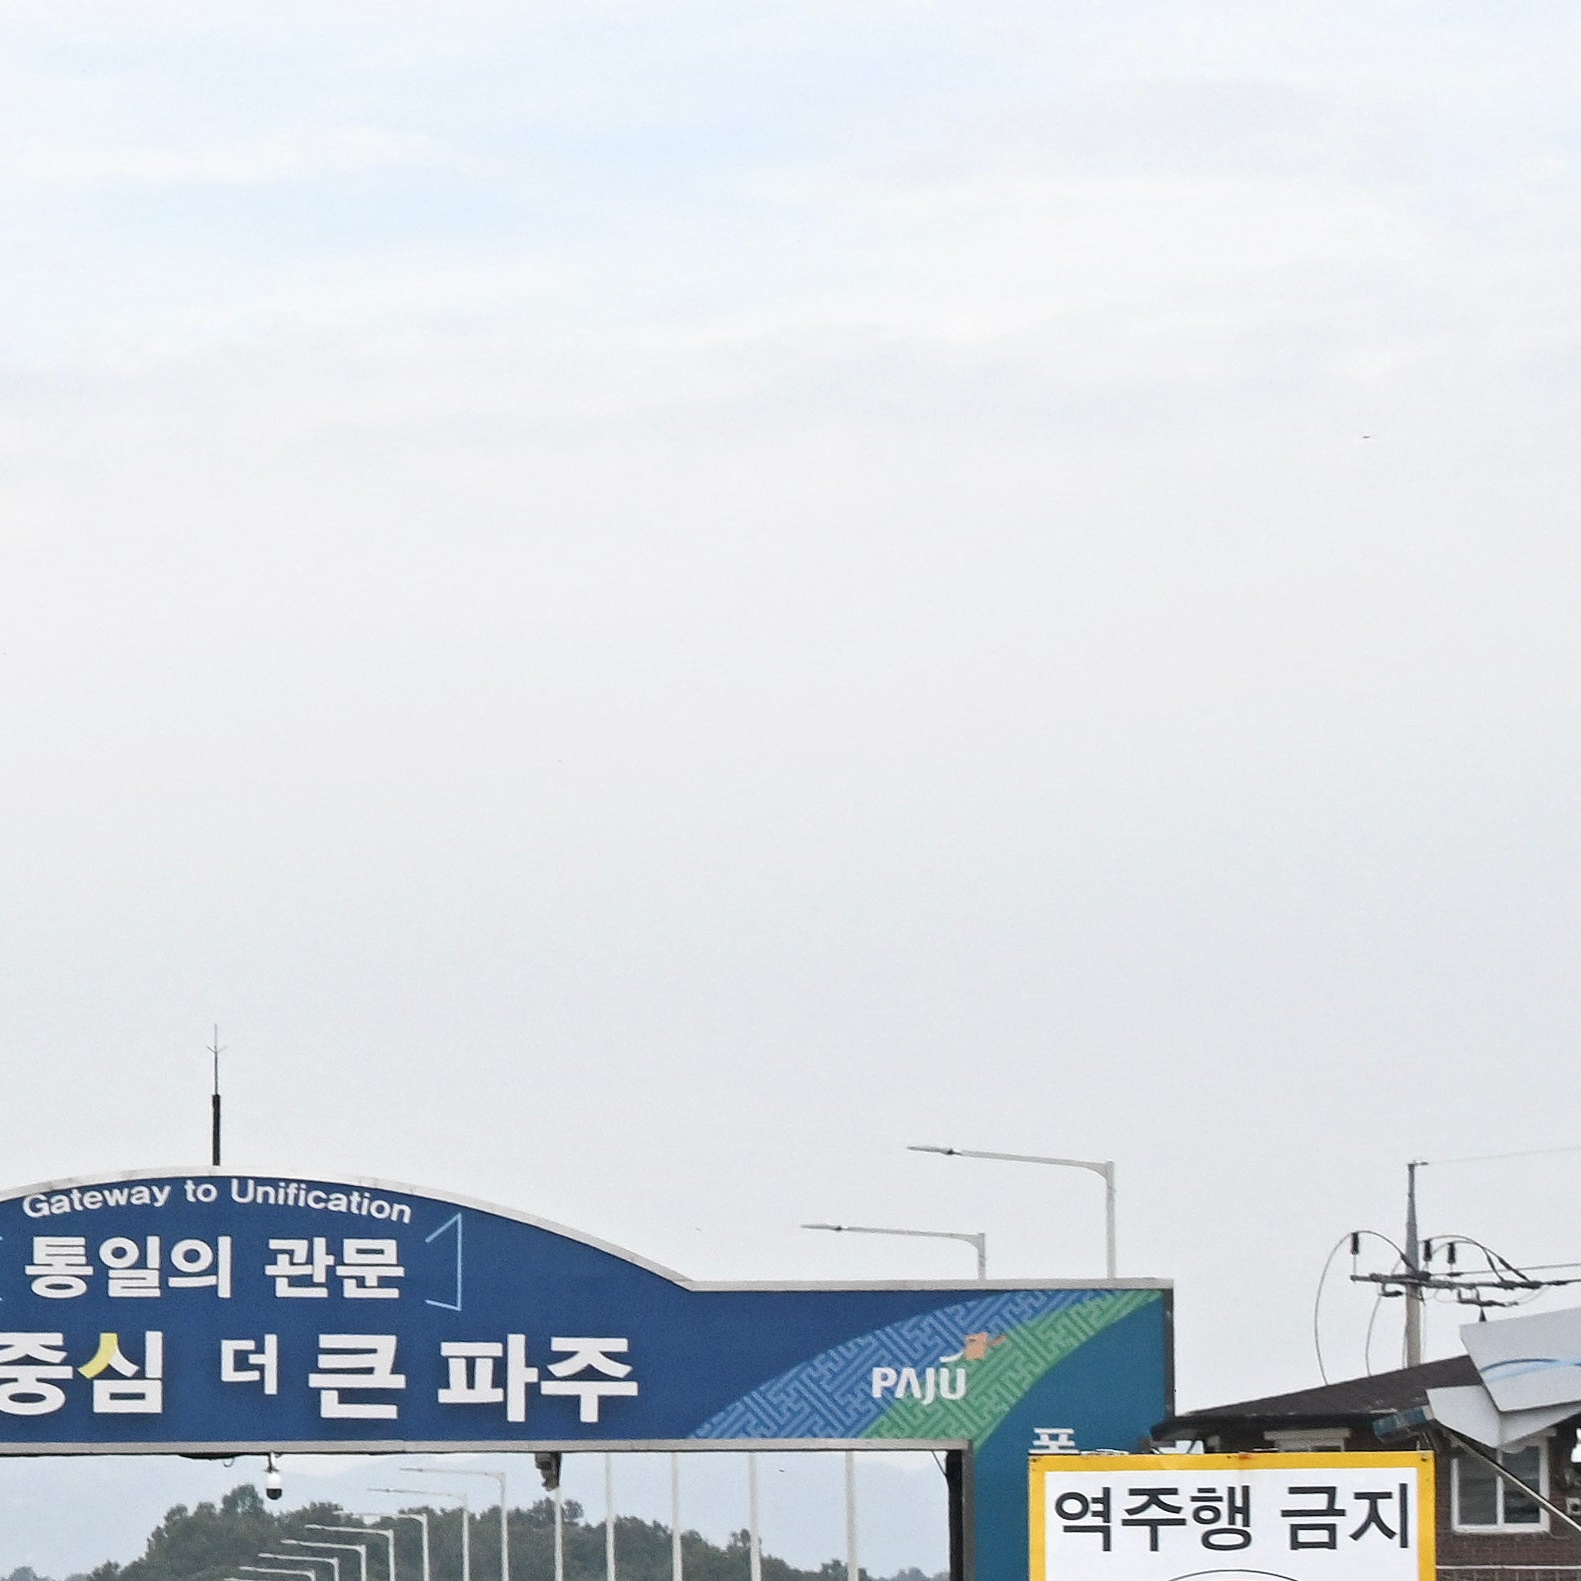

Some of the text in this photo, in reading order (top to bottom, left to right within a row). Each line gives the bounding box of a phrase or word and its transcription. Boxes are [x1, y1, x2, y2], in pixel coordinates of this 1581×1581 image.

[22, 1177, 412, 1225] Gateway to Unification
[24, 1235, 406, 1300] 통일의 관문
[220, 1334, 279, 1396] 더
[307, 1334, 408, 1420] 큰
[438, 1333, 639, 1425] 파주
[1054, 1482, 1411, 1554] 역주행 금지
